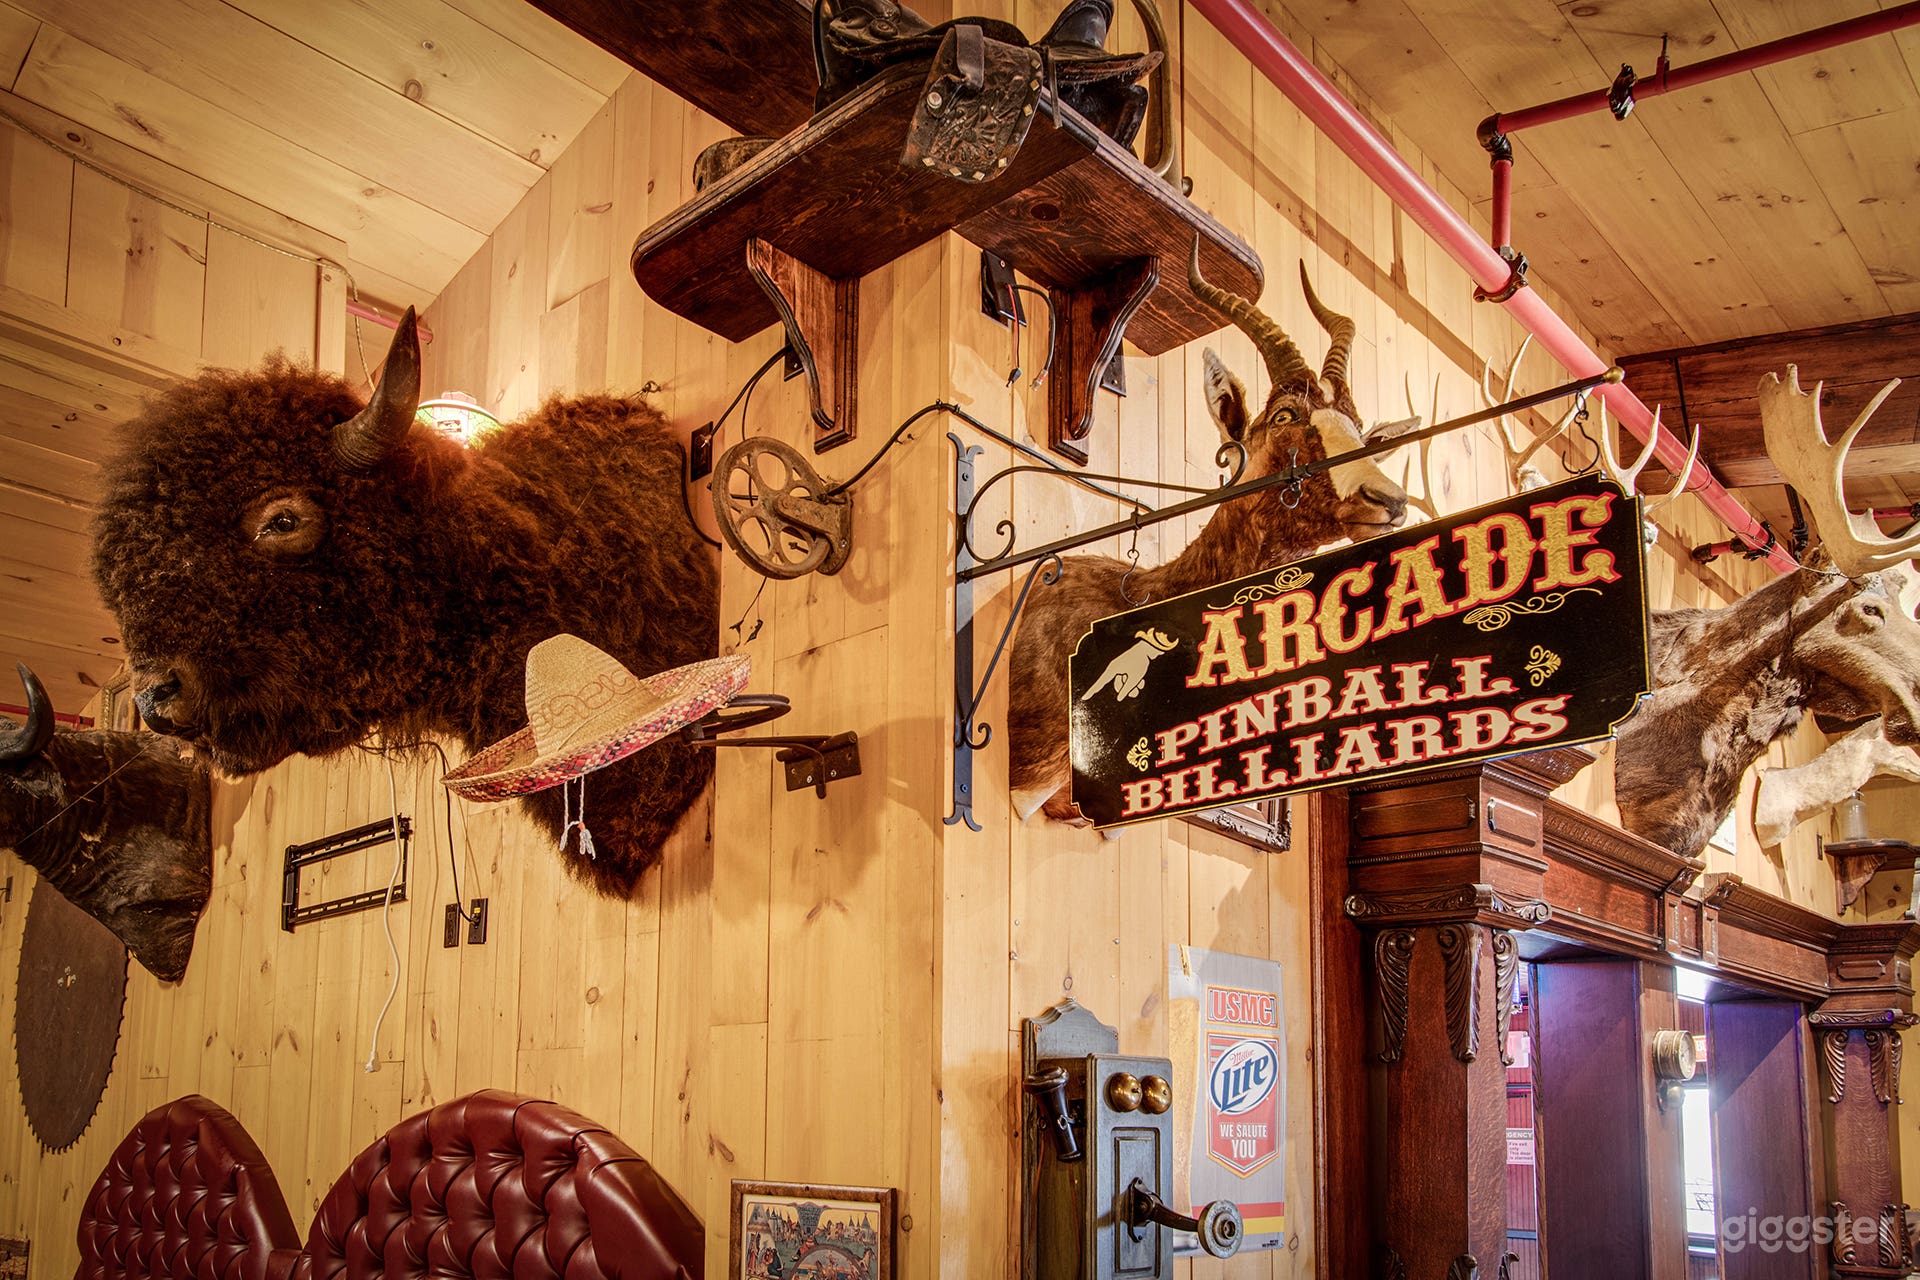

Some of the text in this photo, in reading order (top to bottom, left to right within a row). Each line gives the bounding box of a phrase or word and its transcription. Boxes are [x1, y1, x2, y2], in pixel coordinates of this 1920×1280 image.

[1185, 492, 1622, 688] ARCADE
[1155, 655, 1520, 768] PINBALL
[1121, 694, 1573, 817] BILLIARDS
[1212, 991, 1272, 1025] USMC
[1229, 1049, 1255, 1067] Miller
[1219, 1055, 1269, 1112] Lite
[1220, 1122, 1268, 1139] WE SALUTE
[1231, 1138, 1257, 1159] YOU
